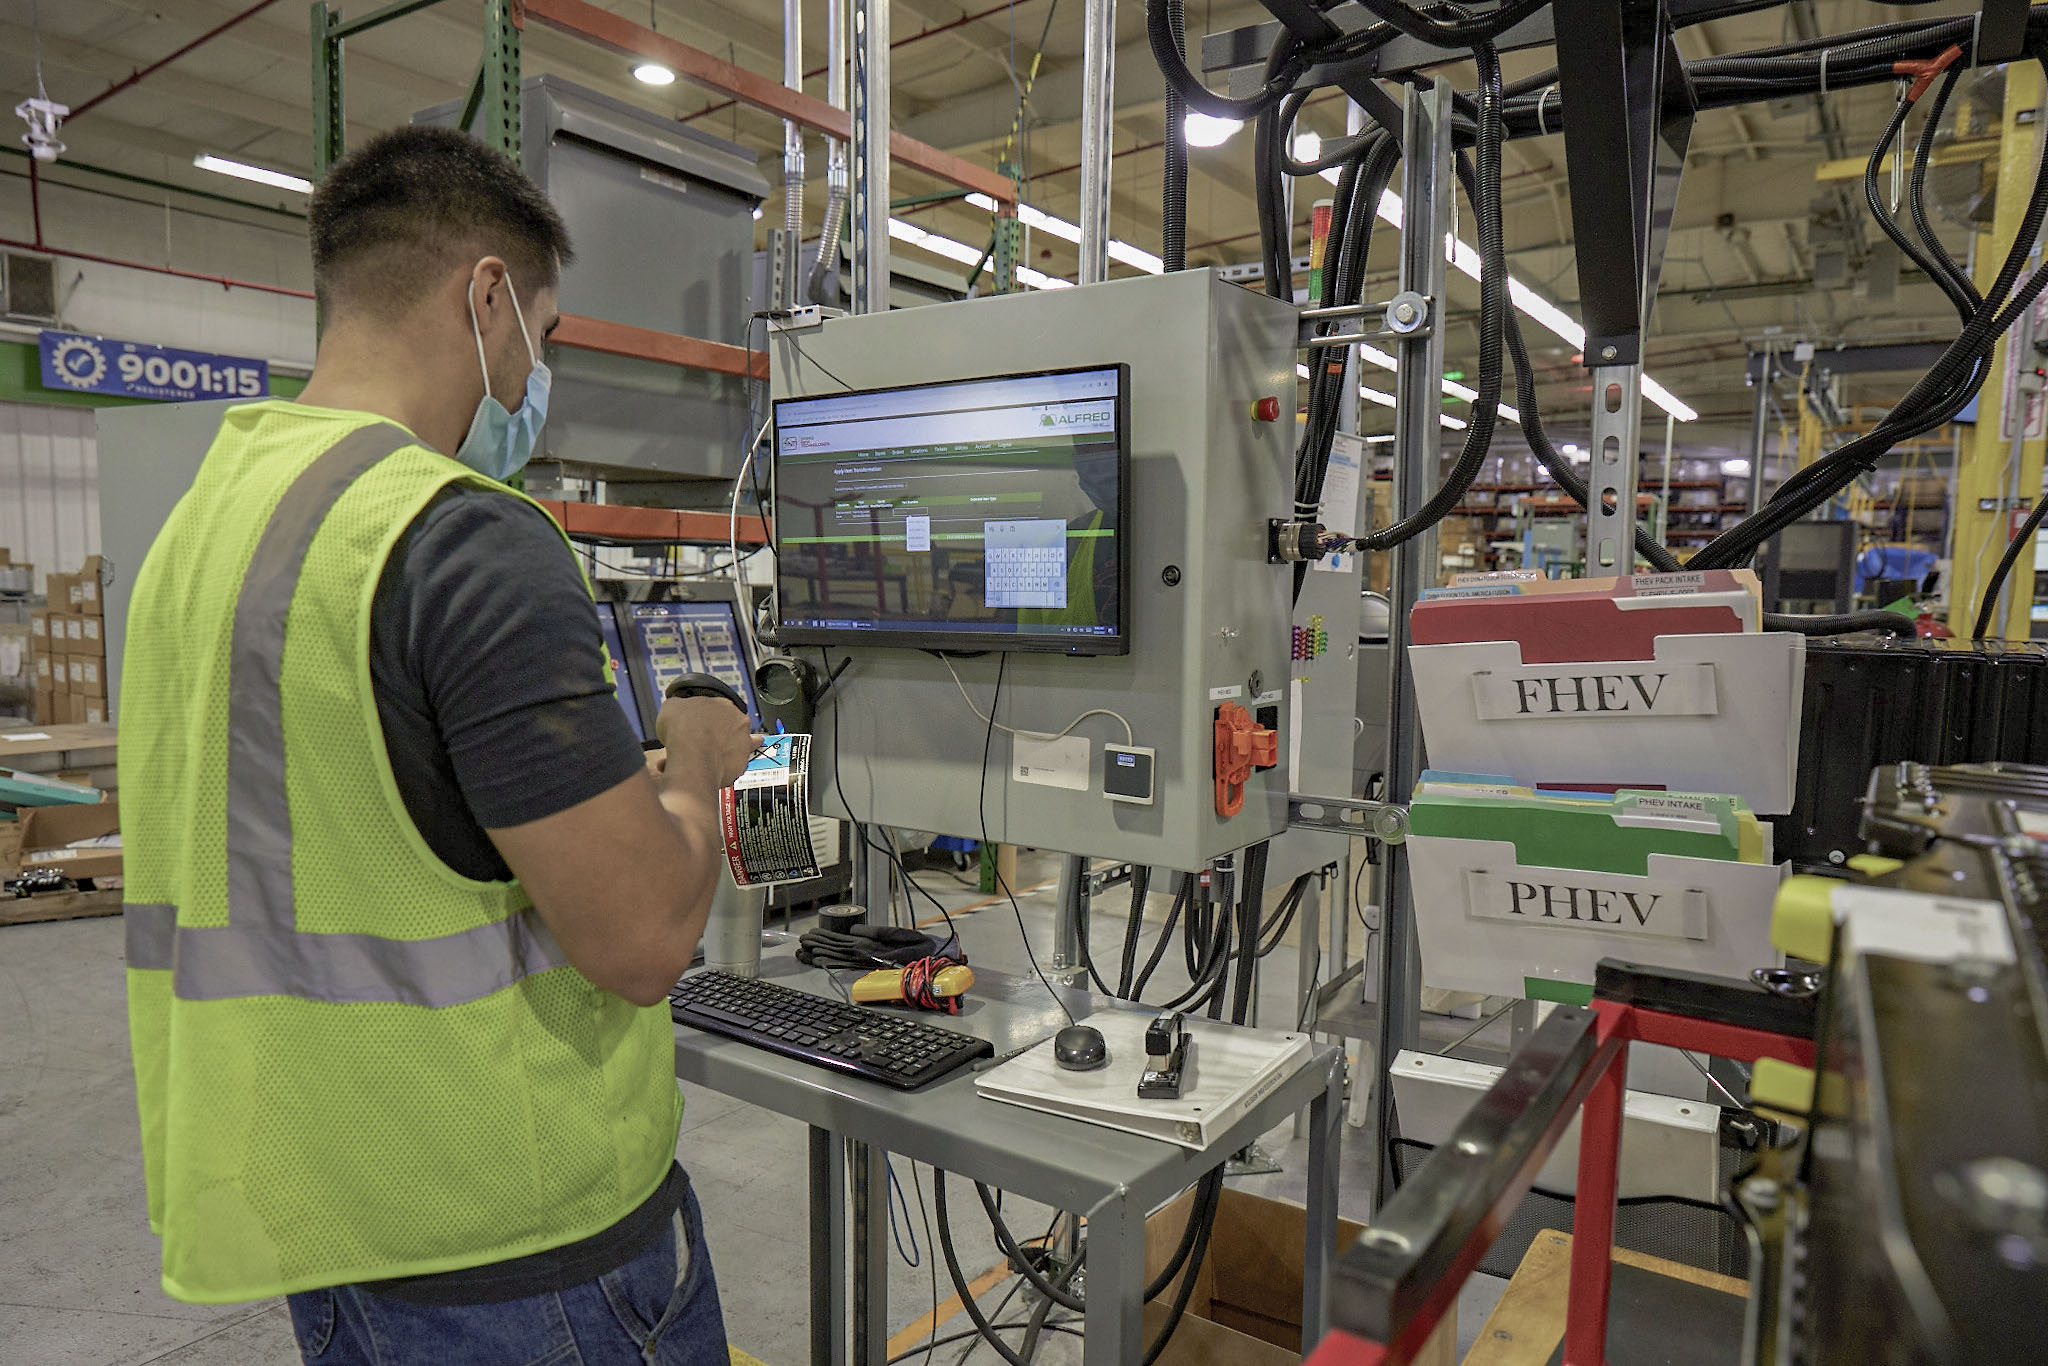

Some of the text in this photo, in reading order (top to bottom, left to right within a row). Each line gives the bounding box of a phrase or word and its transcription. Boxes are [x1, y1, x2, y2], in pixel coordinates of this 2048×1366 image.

[118, 353, 262, 397] 9001:15
[1058, 411, 1111, 424] ALFRED
[1635, 574, 1701, 586] FHEV PACK INTAKE
[1513, 673, 1669, 714] FHEV
[1638, 797, 1665, 807] PHEV
[1667, 800, 1703, 811] INTAKE
[731, 855, 747, 885] DANGER
[1506, 881, 1662, 927] PHEV
